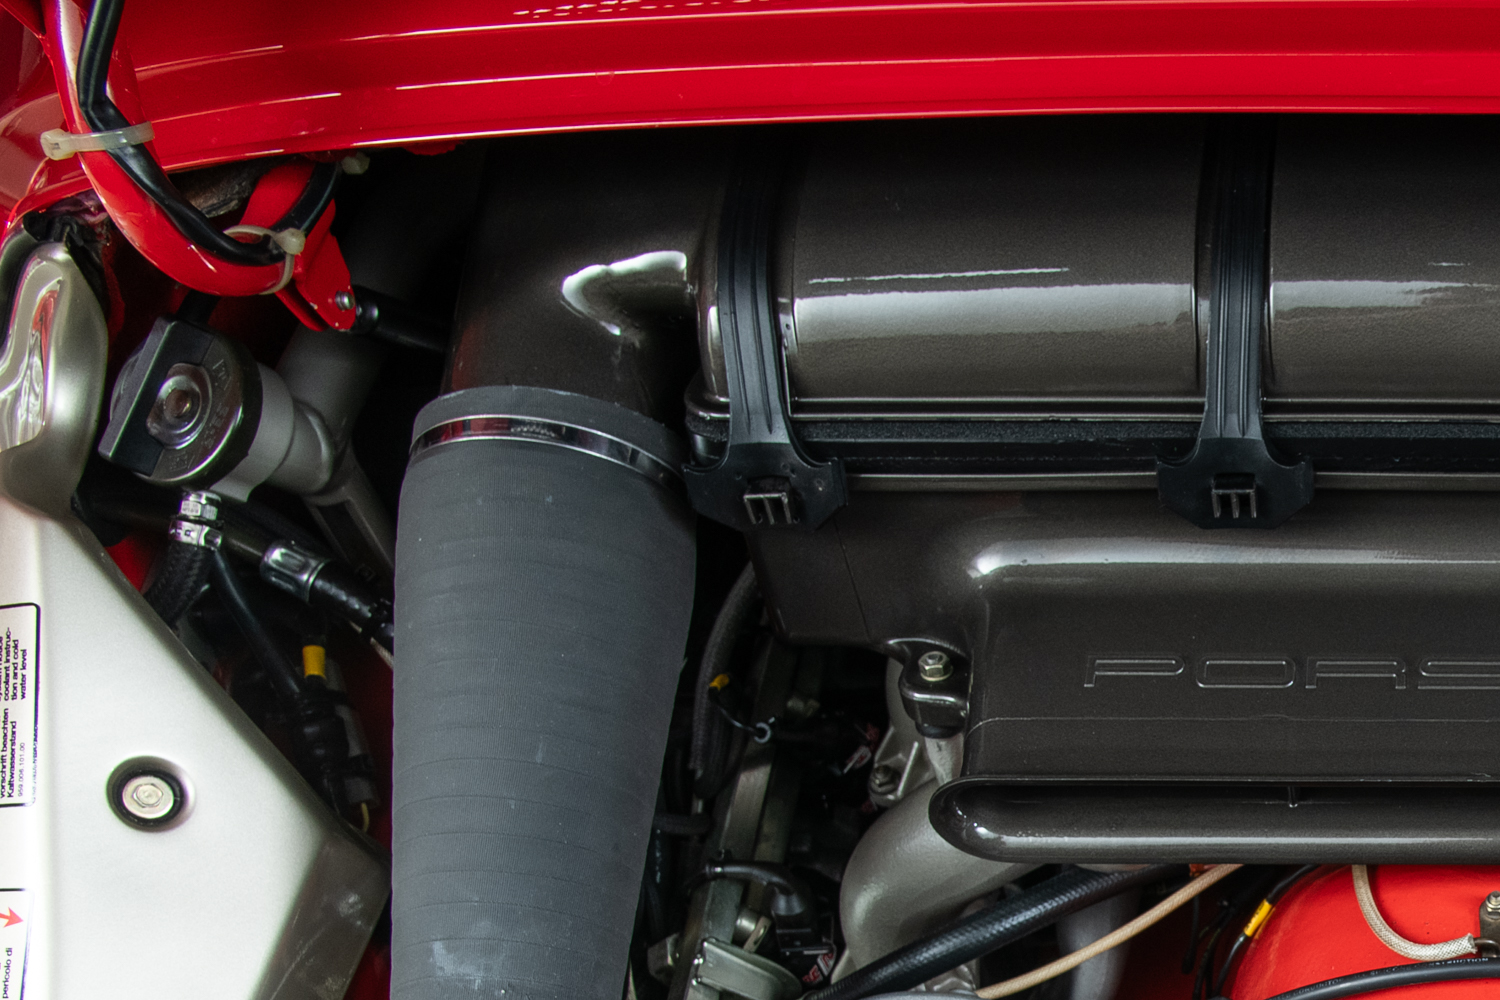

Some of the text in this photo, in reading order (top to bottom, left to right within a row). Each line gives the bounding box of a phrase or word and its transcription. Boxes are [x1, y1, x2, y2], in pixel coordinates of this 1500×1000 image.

[1, 708, 9, 753] beachten
[7, 721, 17, 798] Kaltwasserstand
[5, 947, 13, 957] di
[2, 959, 11, 999] pericolo
